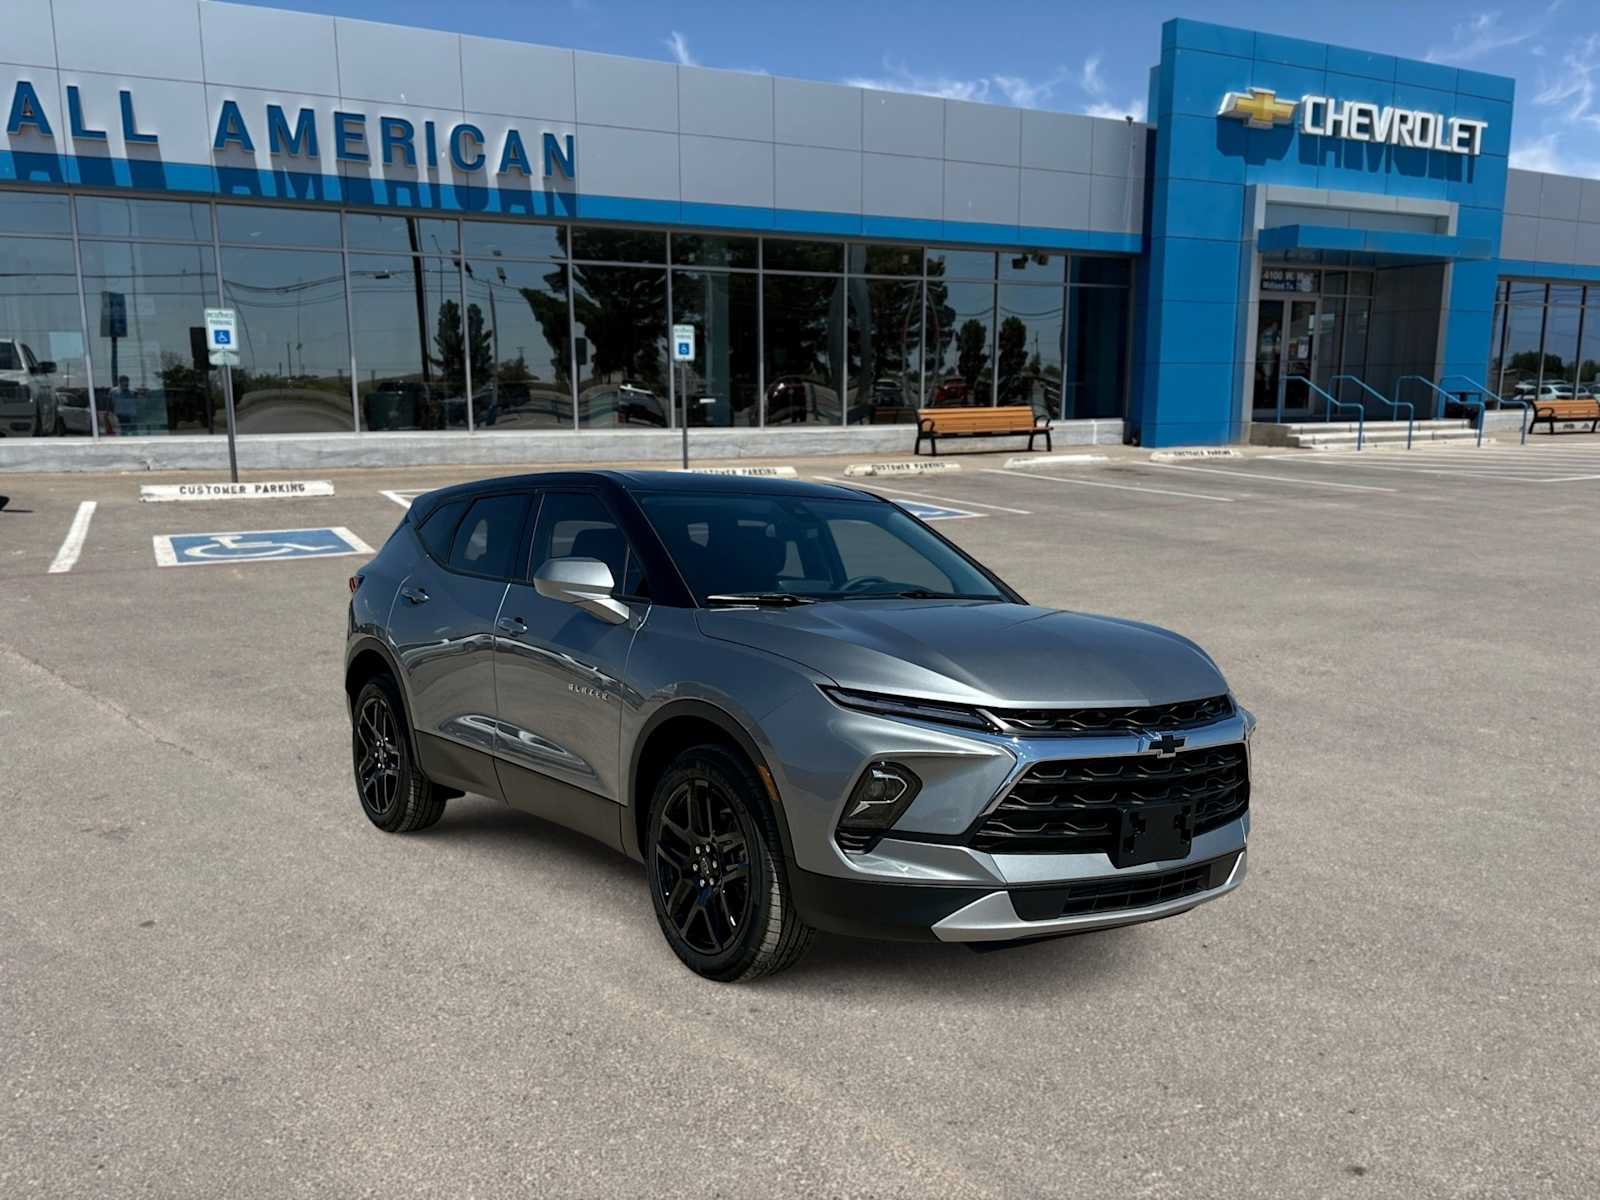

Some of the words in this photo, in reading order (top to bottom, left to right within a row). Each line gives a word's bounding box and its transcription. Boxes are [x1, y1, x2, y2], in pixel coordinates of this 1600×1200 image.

[6, 80, 159, 144] ALL
[212, 99, 576, 179] AMERICAN
[1300, 94, 1489, 156] CHEVROLET
[741, 467, 778, 476] PARKING
[871, 464, 911, 473] CUSTOMER
[913, 462, 946, 470] PARKING
[179, 485, 246, 496] CUSTOMER
[254, 483, 306, 494] PARKING
[568, 682, 609, 702] BLAZER
